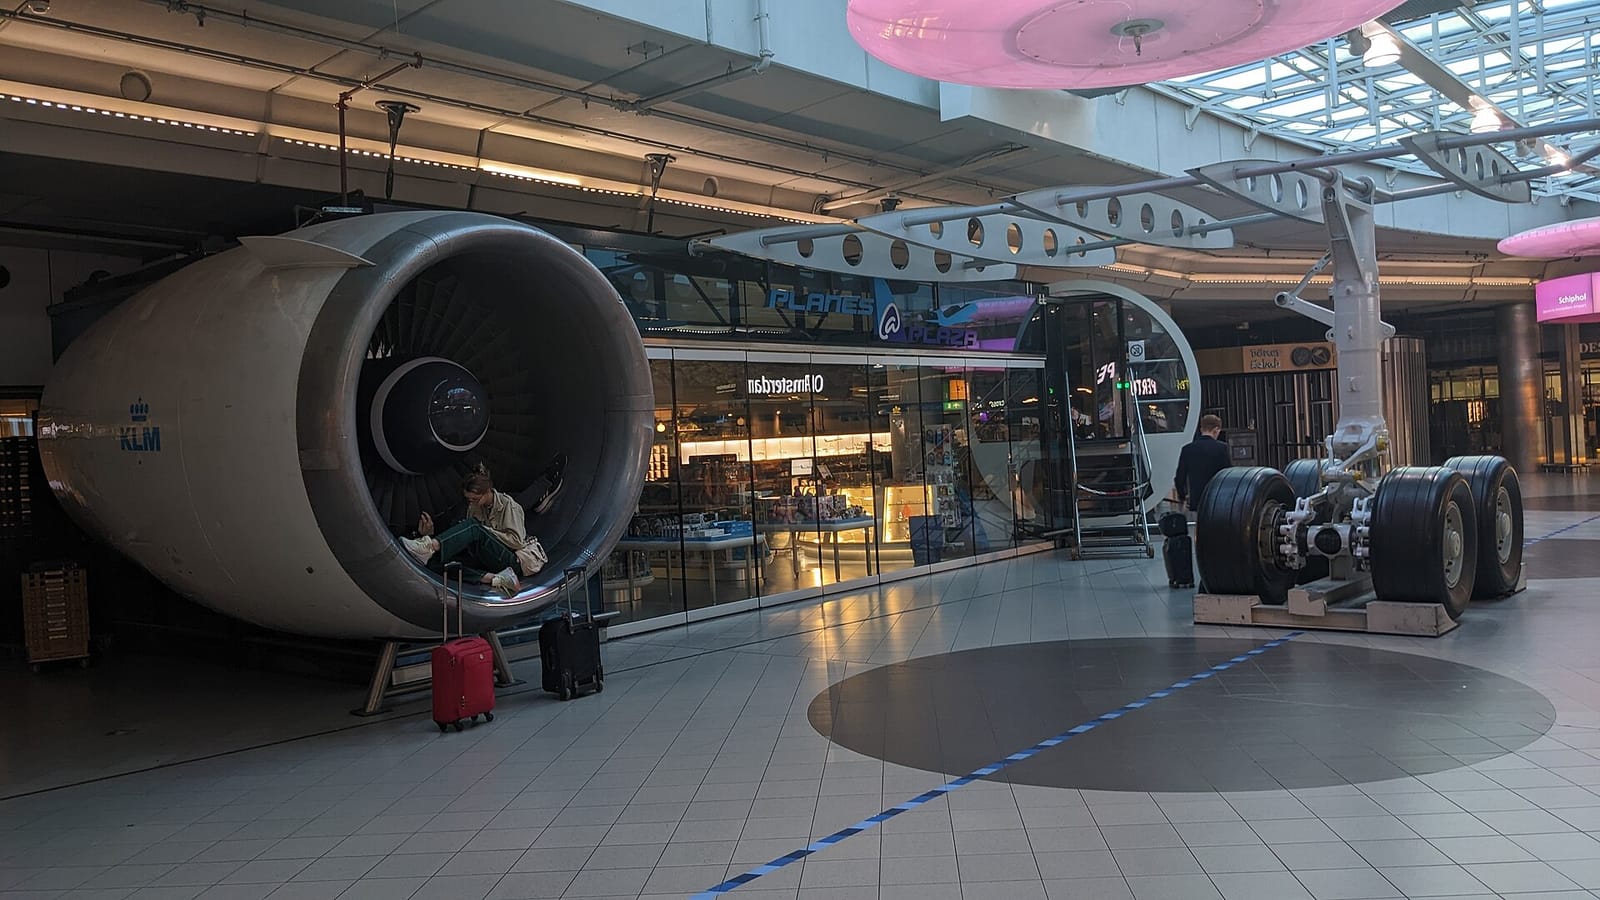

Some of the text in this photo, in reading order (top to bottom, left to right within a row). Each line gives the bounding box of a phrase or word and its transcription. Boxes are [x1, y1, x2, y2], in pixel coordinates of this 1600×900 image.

[770, 290, 875, 315] PLANES
[1558, 293, 1587, 304] Schiphol
[119, 426, 161, 451] KLM
